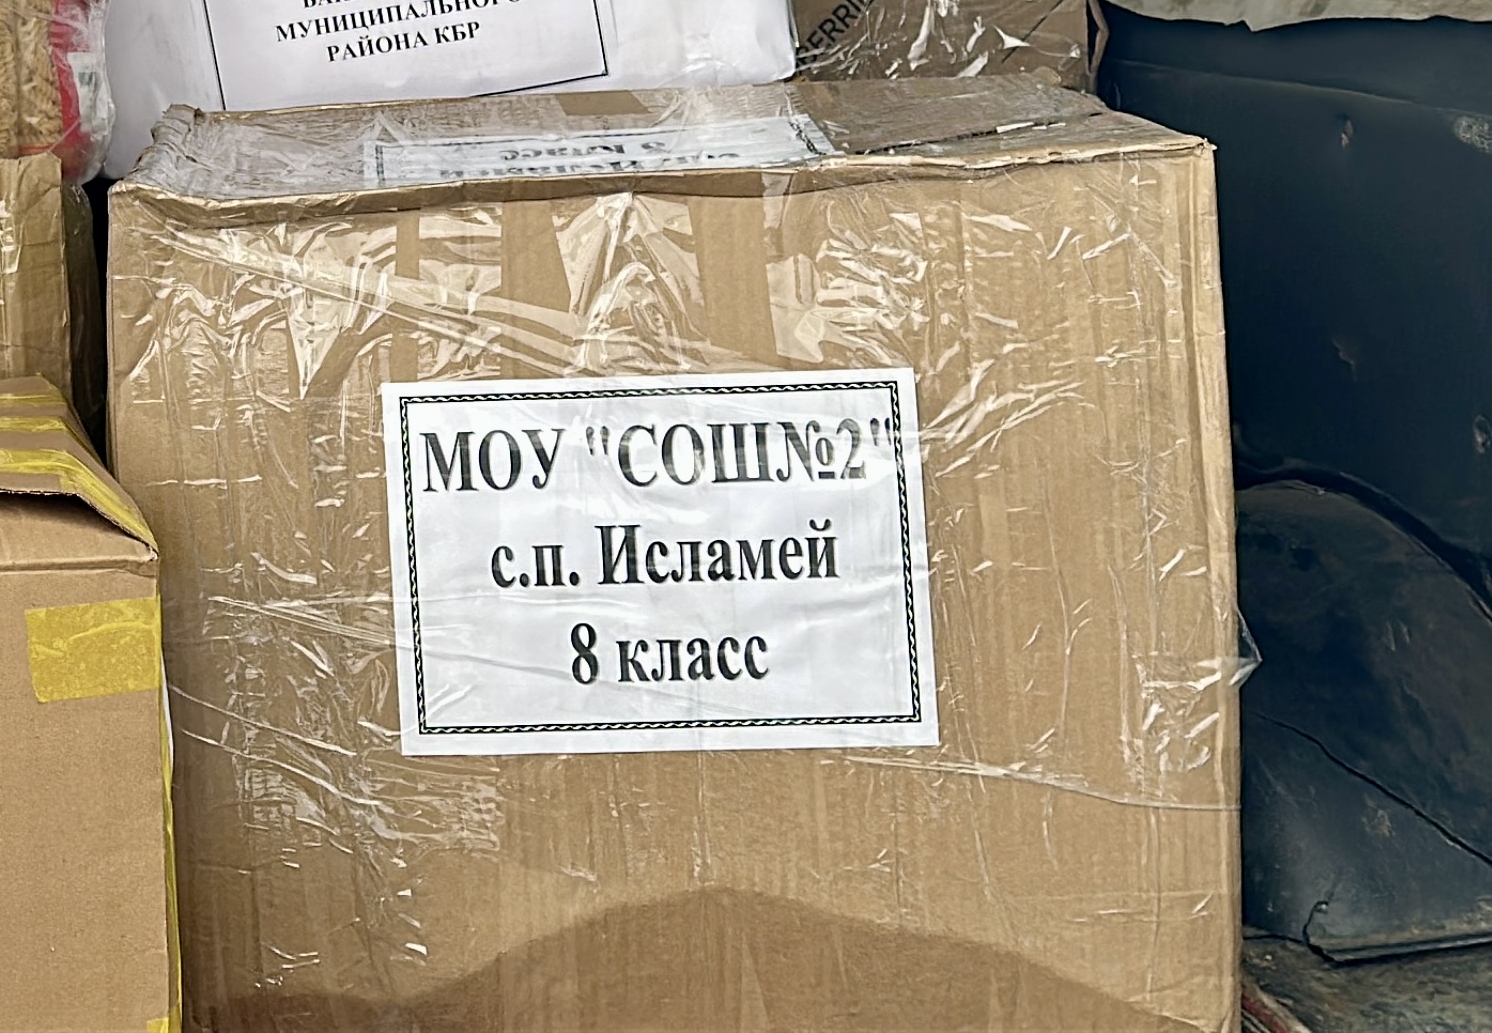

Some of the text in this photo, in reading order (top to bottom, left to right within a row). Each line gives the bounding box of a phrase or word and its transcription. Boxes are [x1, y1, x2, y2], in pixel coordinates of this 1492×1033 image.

[327, 20, 481, 63] РАЙОНА КБР
[420, 416, 894, 493] МОУ "СОШ№2"
[491, 518, 839, 589] с.п. Исламей
[570, 621, 769, 685] 8 класс
